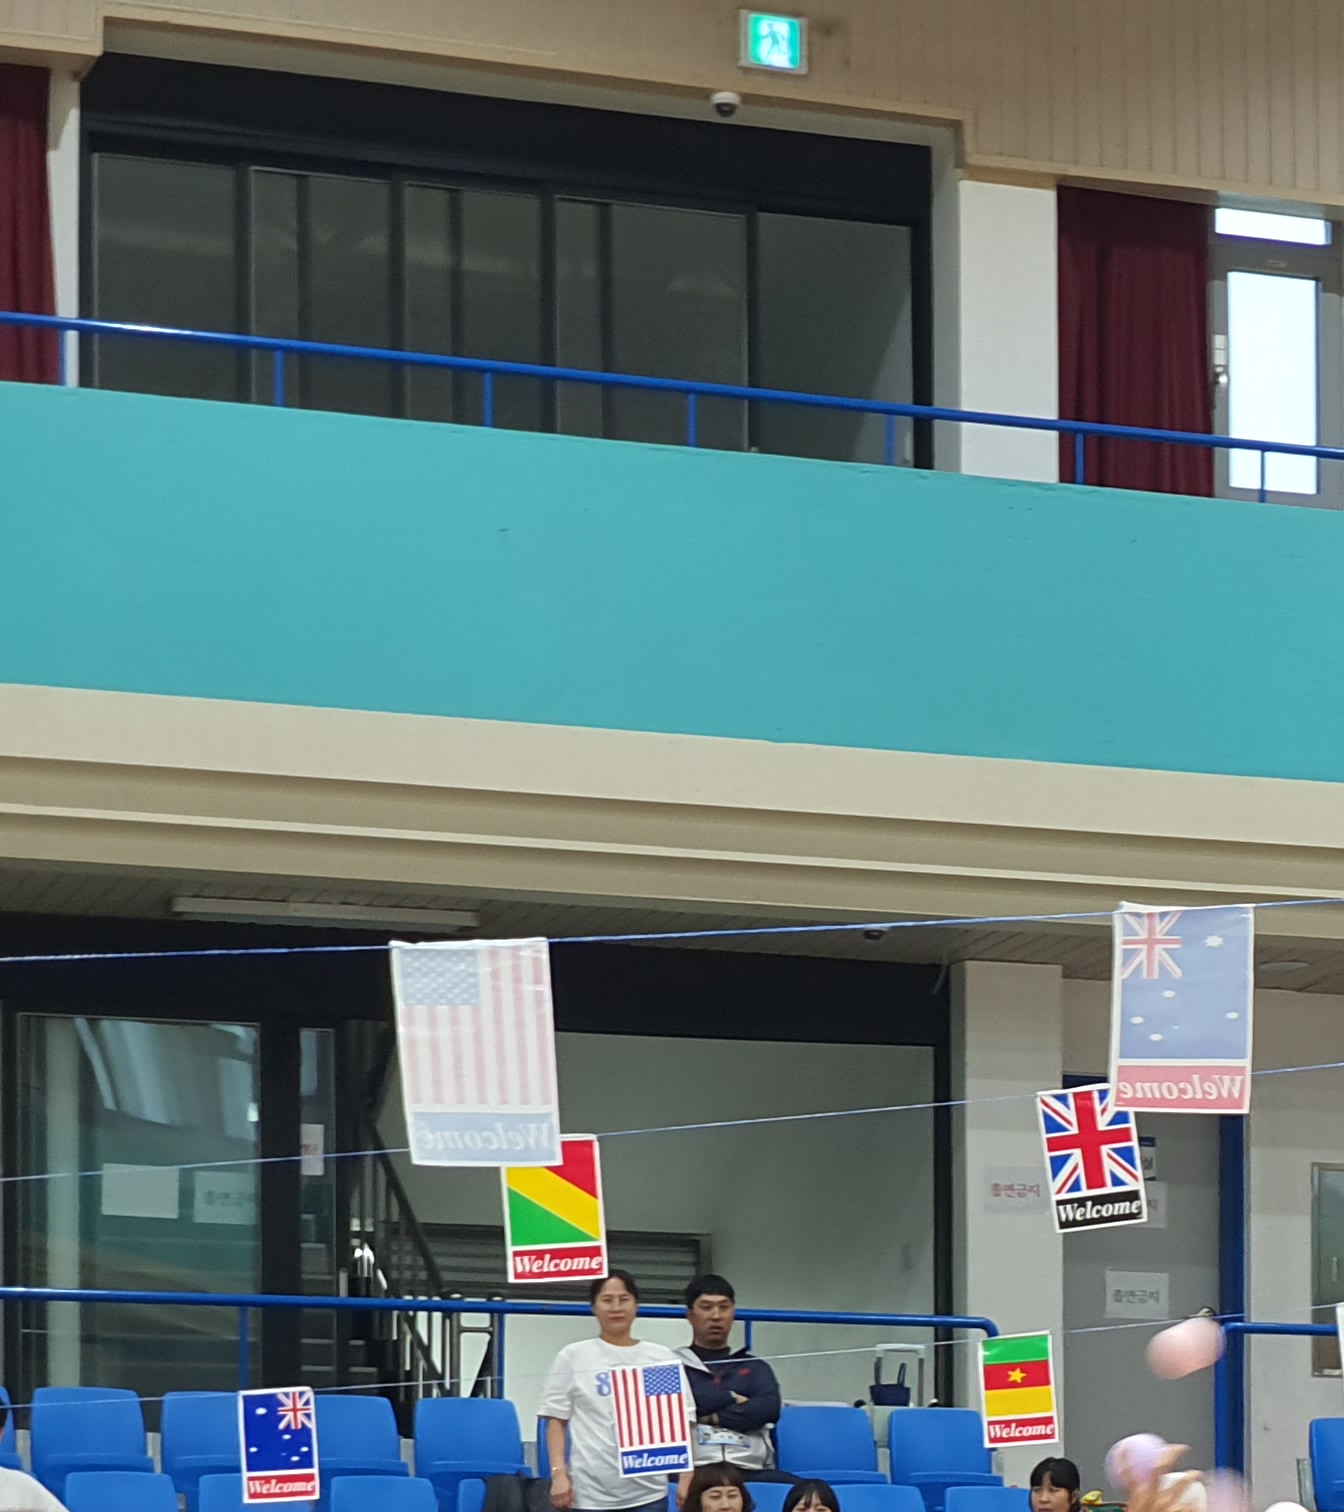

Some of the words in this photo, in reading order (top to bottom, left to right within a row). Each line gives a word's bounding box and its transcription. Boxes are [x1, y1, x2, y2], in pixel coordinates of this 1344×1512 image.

[1057, 1199, 1142, 1222] Welcome
[514, 1254, 603, 1274] Welcome
[988, 1421, 1054, 1439] Welcome
[622, 1450, 688, 1469] Welcome
[248, 1476, 316, 1495] Welcome
